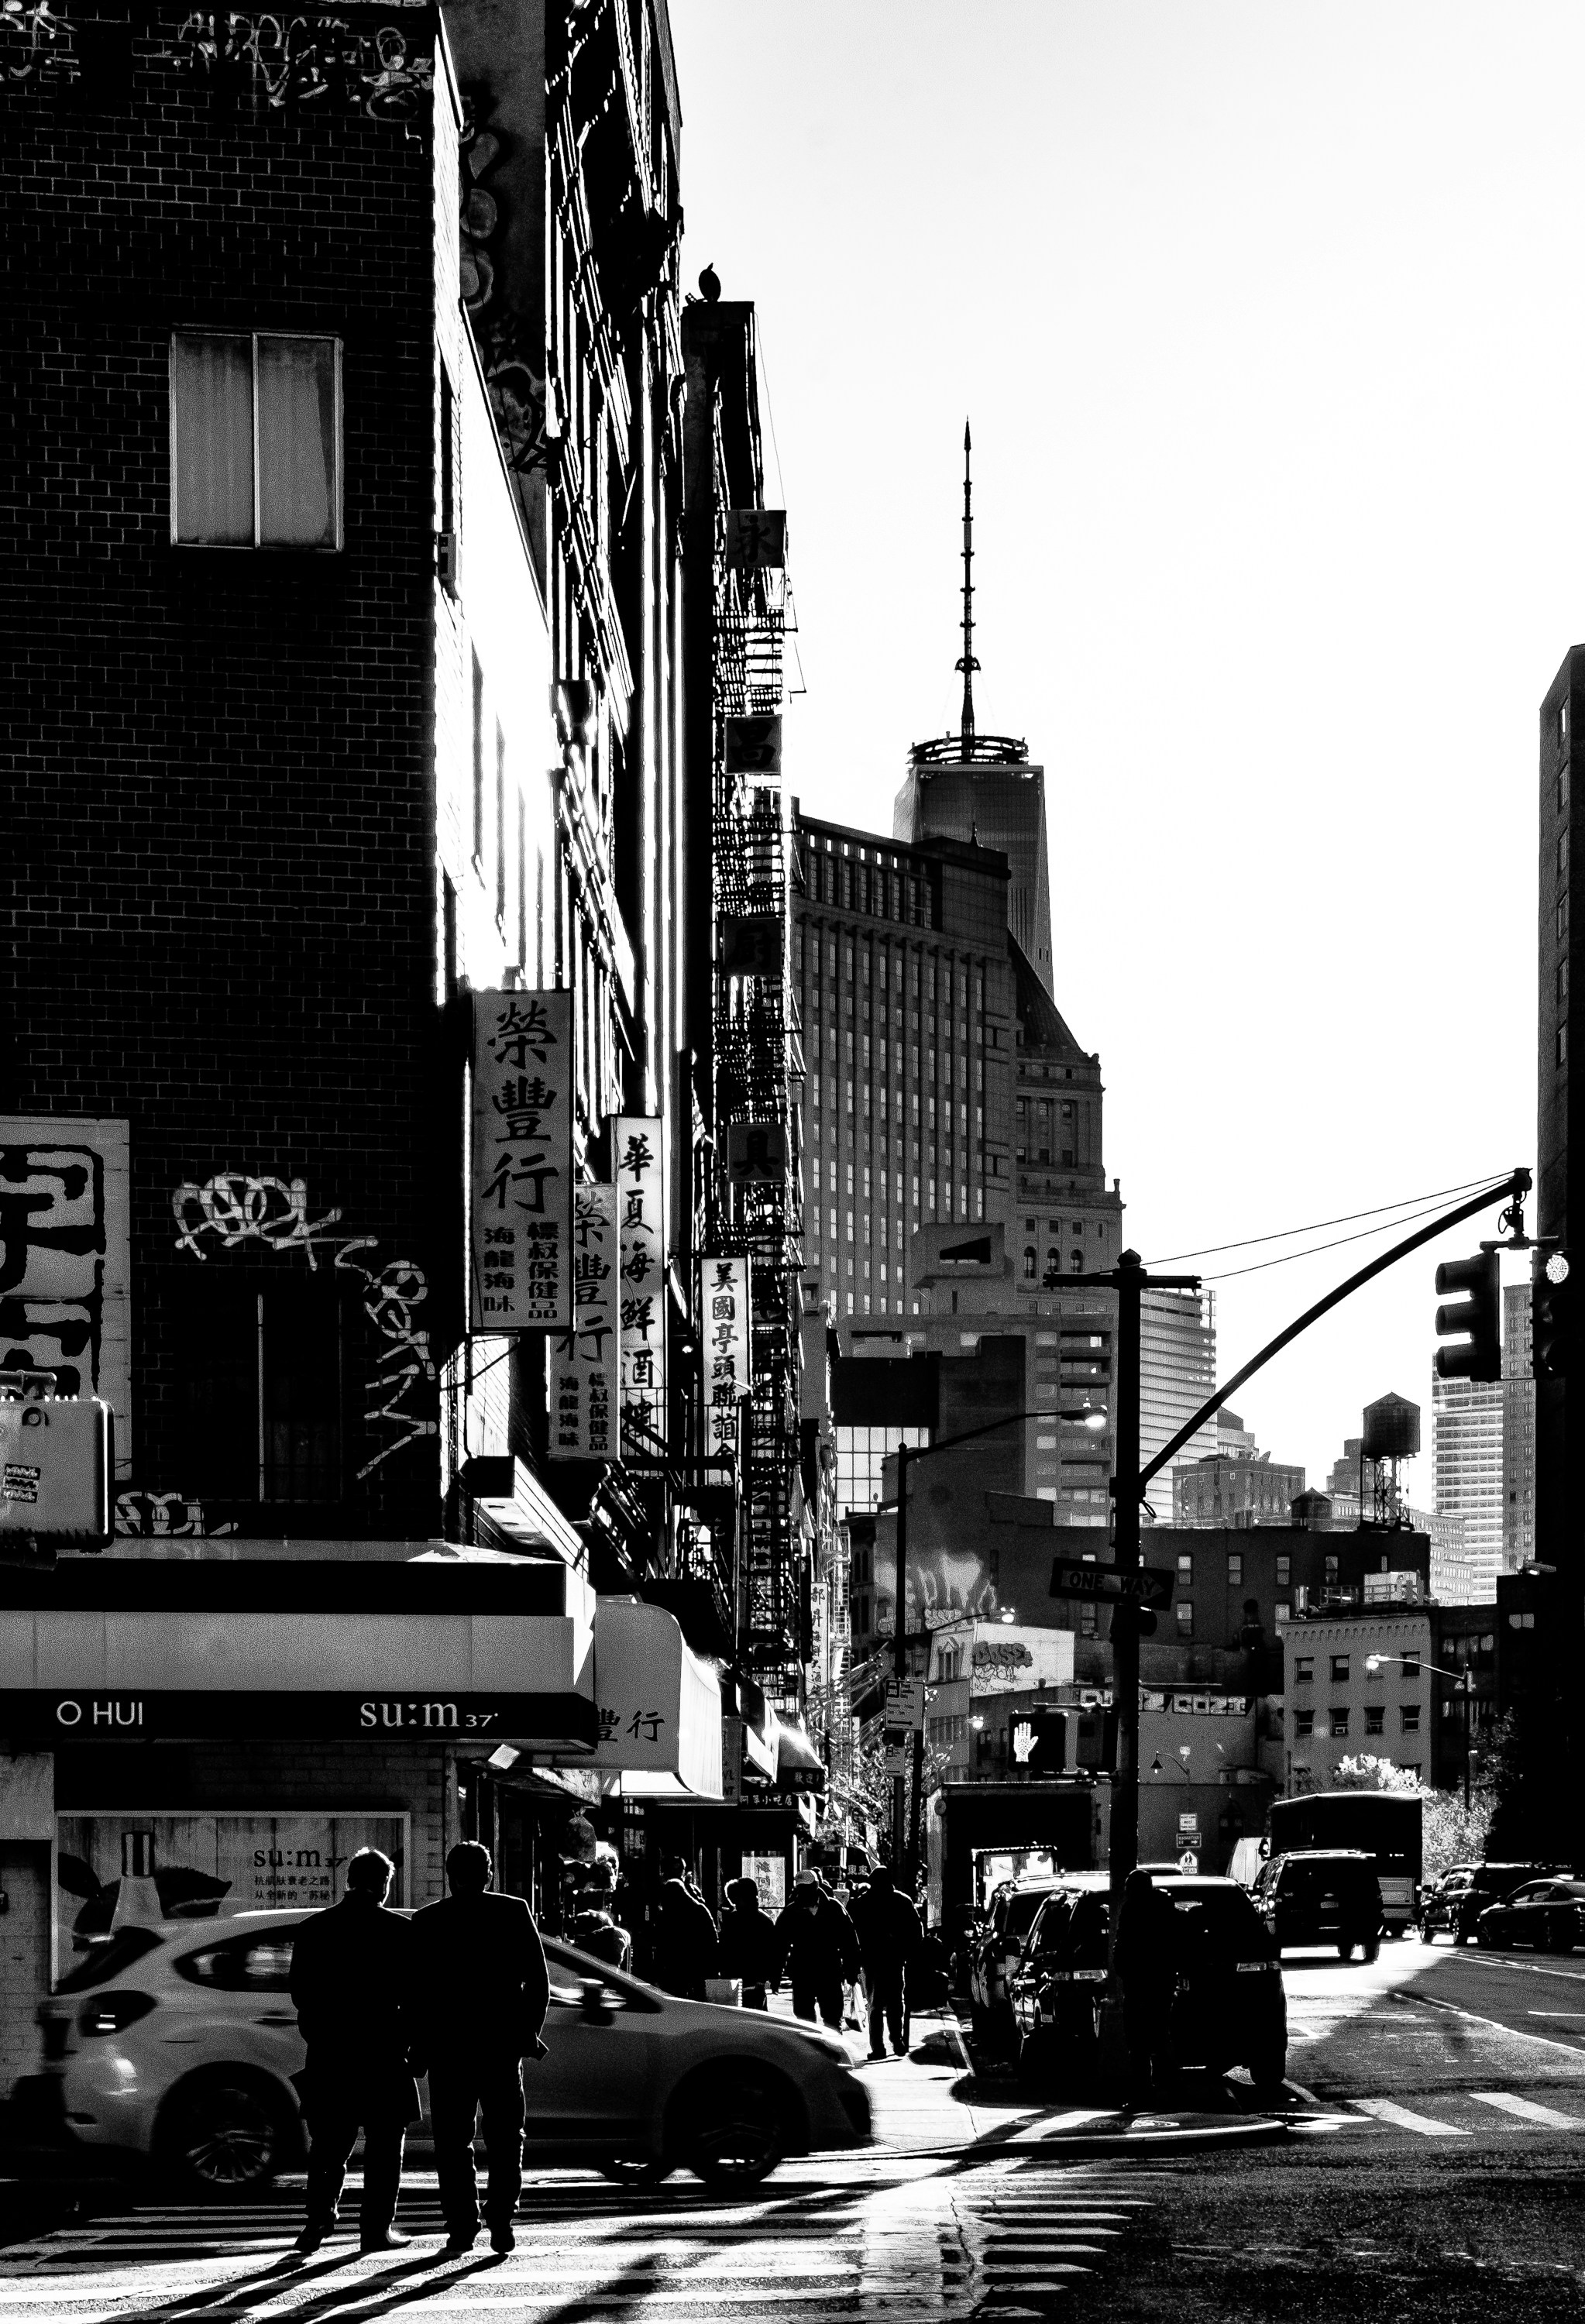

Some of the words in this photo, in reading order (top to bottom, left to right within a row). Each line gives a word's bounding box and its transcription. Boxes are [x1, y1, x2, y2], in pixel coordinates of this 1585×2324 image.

[481, 999, 559, 1214] 榮豐行
[710, 1263, 738, 1463] 美國亭頭聯誼
[1068, 1571, 1105, 1590] ONE
[1120, 1576, 1156, 1596] WAY
[56, 1700, 82, 1726] O
[92, 1701, 143, 1726] HUI
[597, 1707, 665, 1743] 豐行
